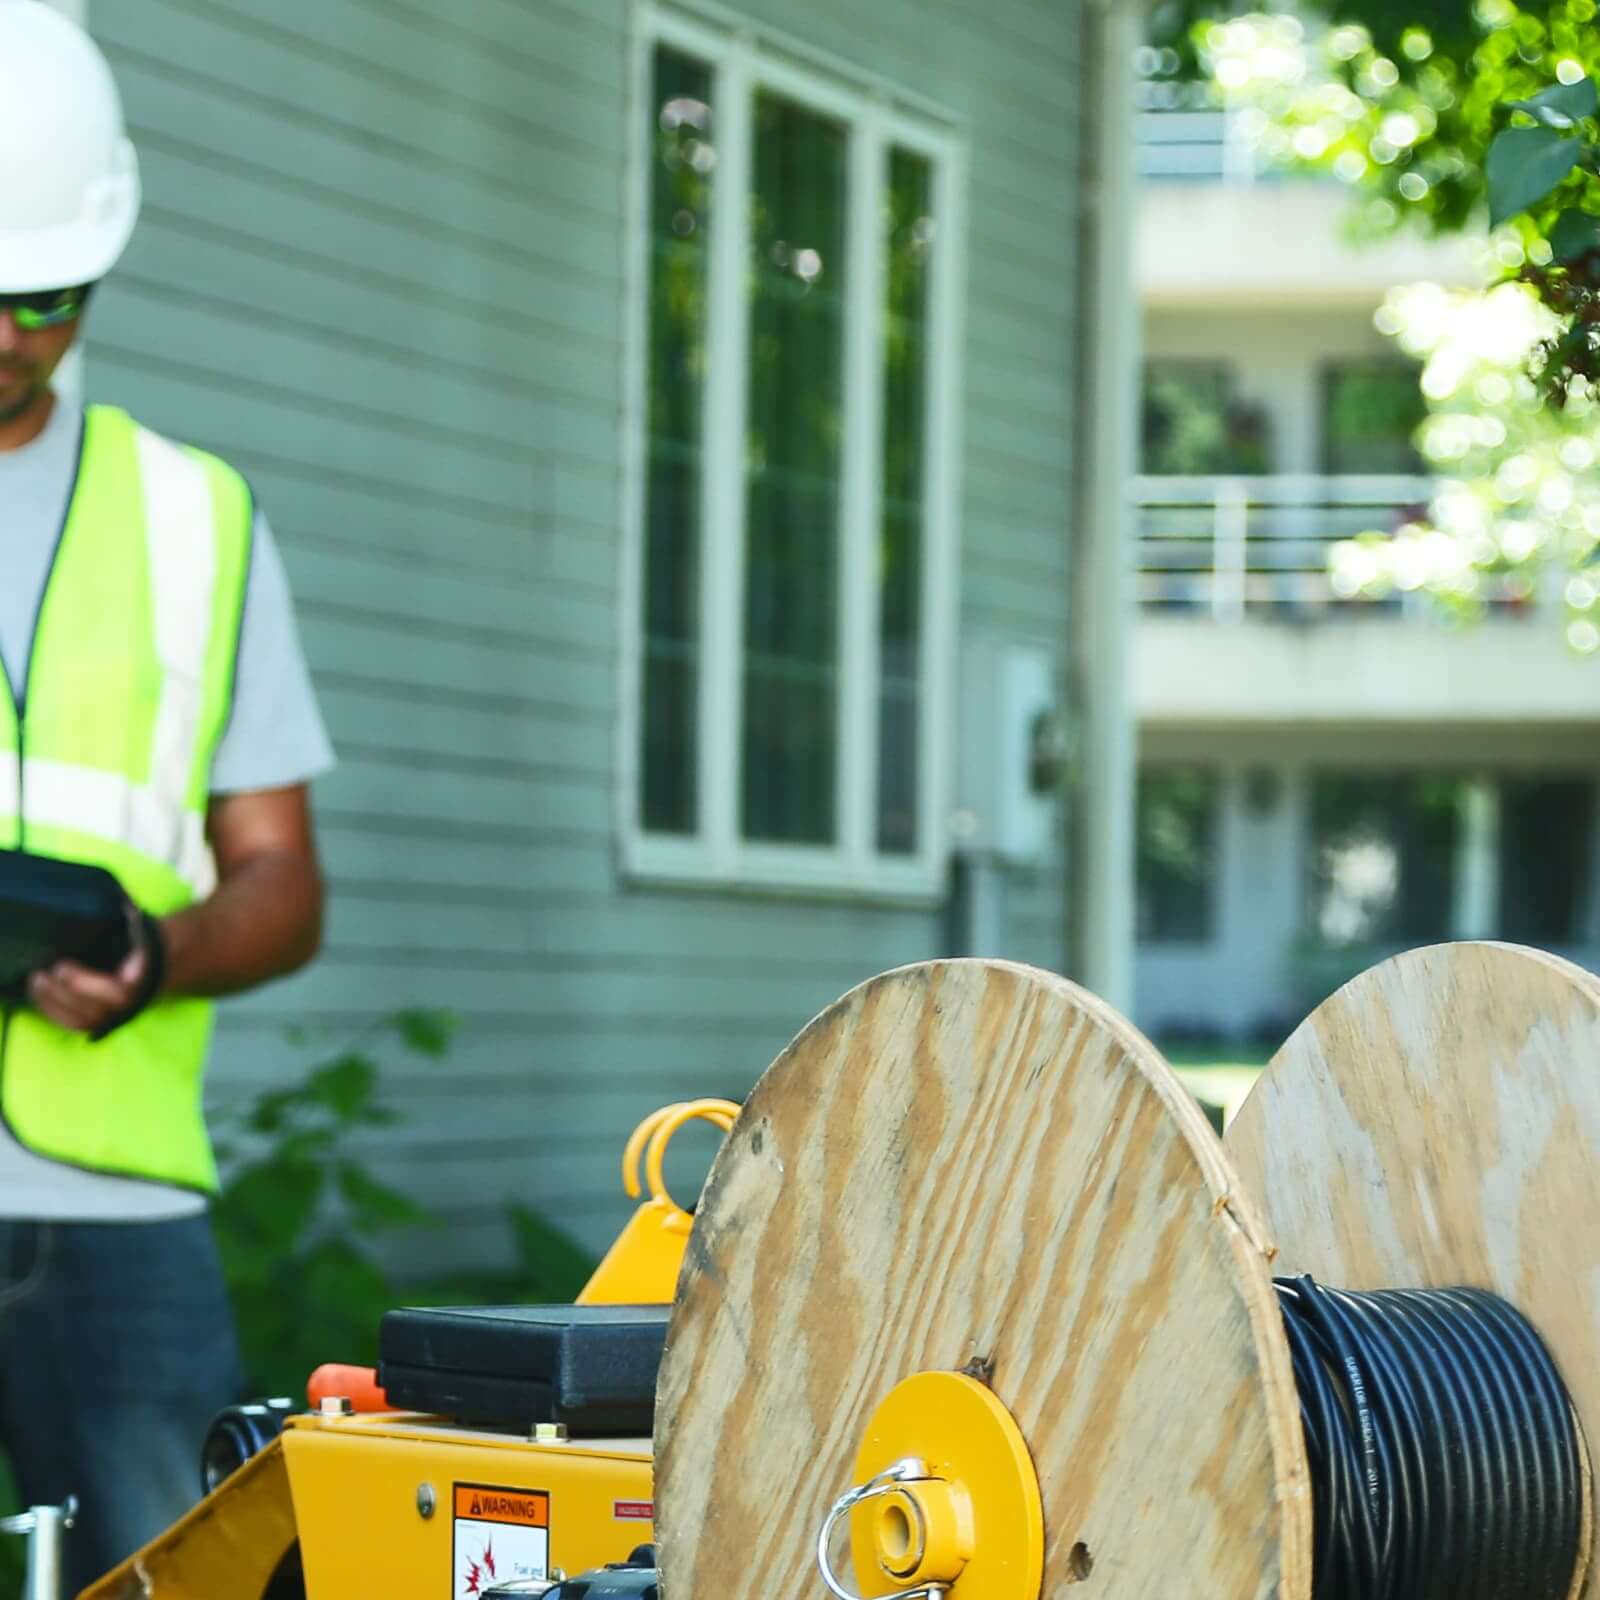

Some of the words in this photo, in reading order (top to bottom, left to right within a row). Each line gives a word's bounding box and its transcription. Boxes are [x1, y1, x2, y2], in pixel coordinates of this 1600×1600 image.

[1344, 1356, 1367, 1404] SUPERIOR
[1367, 1468, 1379, 1496] 2016
[481, 1496, 535, 1519] WARNING
